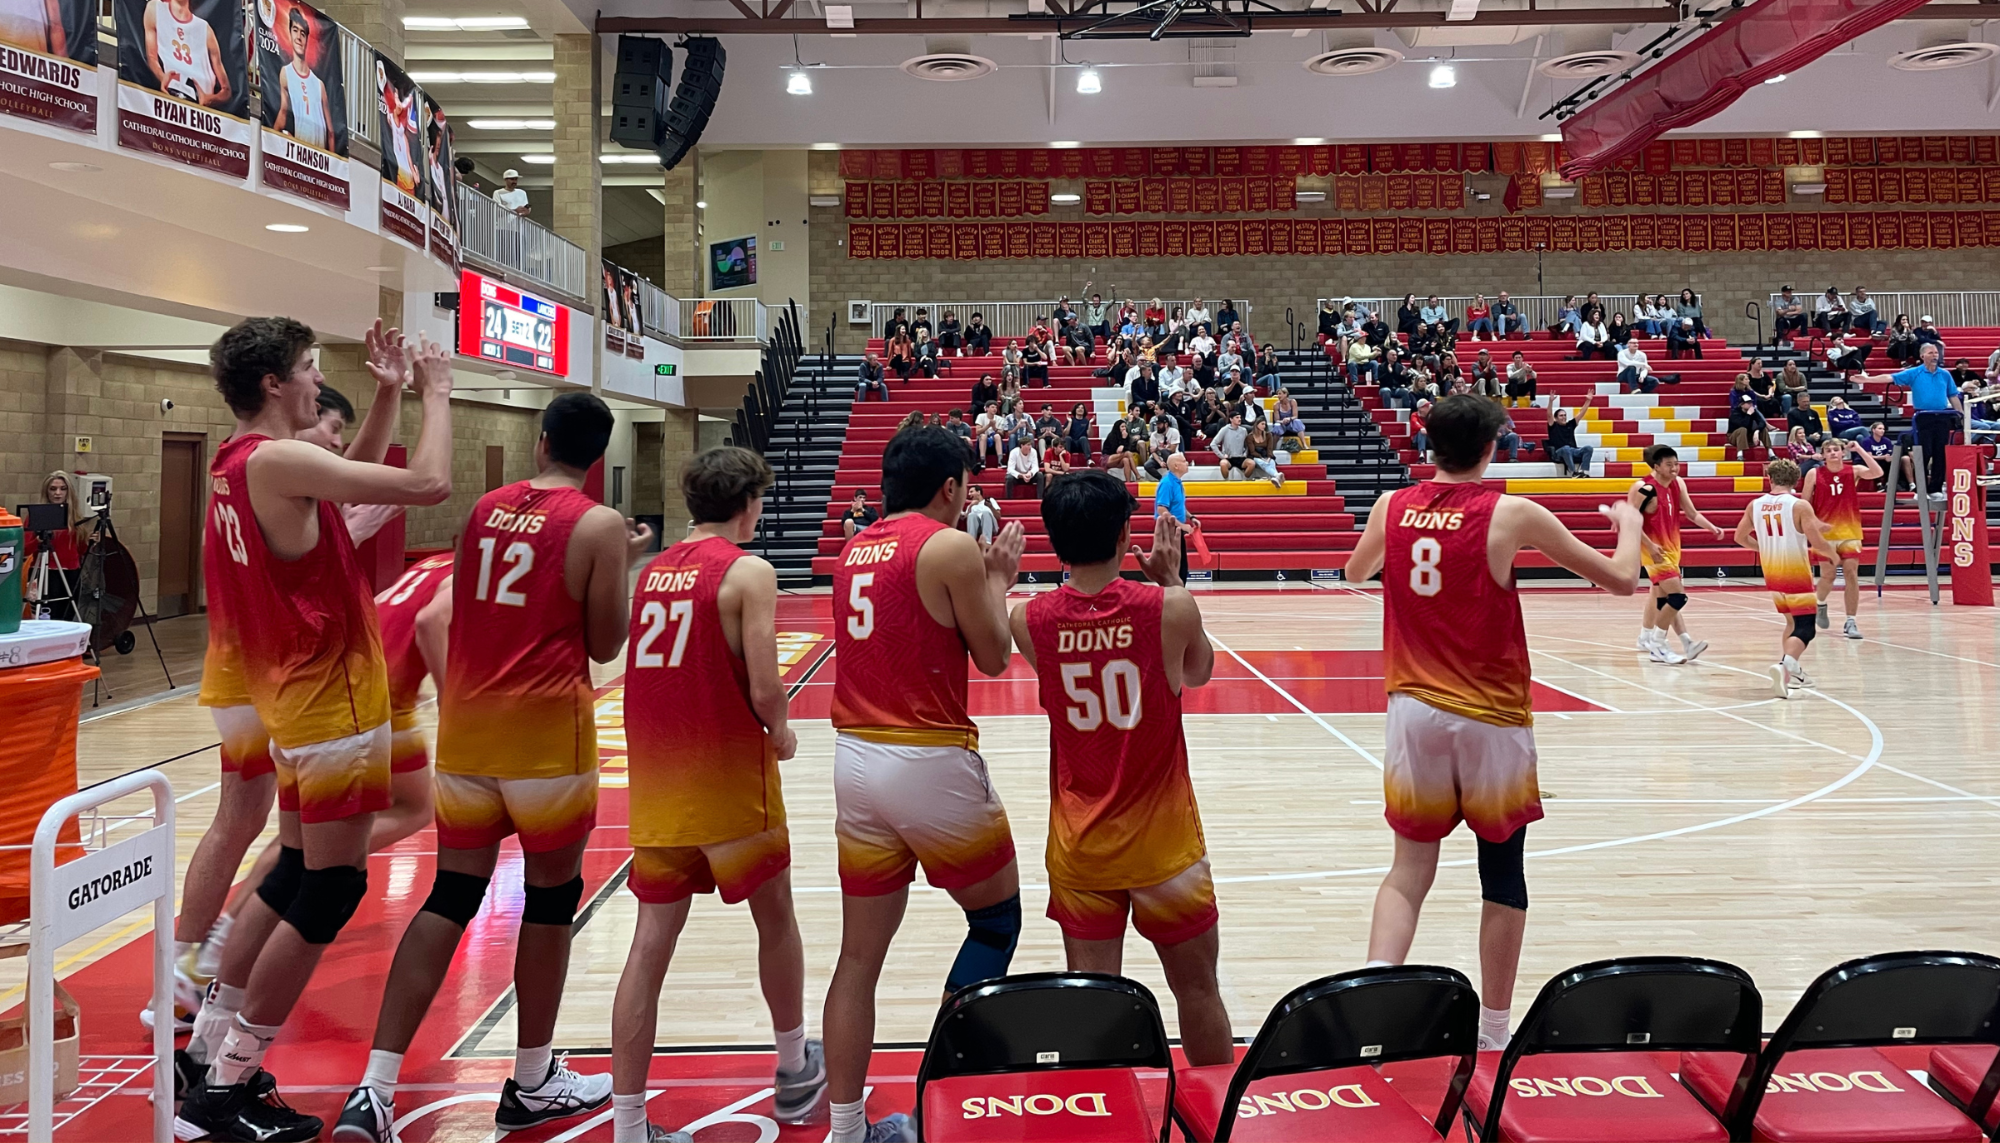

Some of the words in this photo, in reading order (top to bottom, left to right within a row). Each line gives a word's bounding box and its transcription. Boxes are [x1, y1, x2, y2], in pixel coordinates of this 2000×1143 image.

[171, 39, 193, 66] 33
[258, 35, 280, 56] 2024
[0, 47, 81, 89] EDWARDS
[29, 88, 53, 104] HIGH
[54, 97, 90, 114] SCHOOL
[154, 98, 187, 125] RYAN
[190, 108, 222, 135] ENOS
[122, 120, 166, 139] CATHEDRAL
[165, 130, 201, 149] CATHOLIC
[201, 142, 220, 155] HIGH
[219, 147, 246, 161] SCHOOL
[152, 141, 174, 155] DONS
[177, 149, 221, 167] VOLLEYBALL
[285, 141, 296, 158] JT
[296, 145, 330, 173] HANSON
[264, 160, 293, 181] CATHEDRAL
[293, 171, 316, 186] CATHOLIC
[315, 177, 328, 190] HIGH
[327, 182, 346, 195] SCHOOL
[851, 227, 872, 235] WESTERN
[1060, 226, 1081, 234] WESTERN
[1086, 226, 1108, 234] WESTERN
[1165, 225, 1186, 233] WESTERN
[1218, 224, 1238, 232] WESTERN
[1684, 218, 1707, 226] WESTERN
[1877, 216, 1899, 224] WESTERN
[486, 306, 502, 340] 24
[525, 322, 530, 340] 2
[537, 323, 552, 353] 22
[661, 365, 673, 375] EXIT
[1398, 508, 1465, 531] DONS
[1761, 503, 1783, 512] DONS
[1952, 469, 1975, 567] DONS
[485, 508, 546, 534] DONS
[1762, 513, 1784, 537] 11
[844, 541, 898, 567] DONS
[1409, 536, 1442, 597] 8
[475, 537, 535, 607] 12
[644, 570, 699, 593] DONS
[847, 572, 875, 641] 5
[635, 599, 694, 669] 27
[1057, 621, 1096, 629] CATHEDRAL
[1097, 616, 1132, 627] CATHOLIC
[1057, 624, 1134, 653] DONS
[1060, 658, 1142, 732] 50
[68, 855, 152, 911] GATORADE
[1509, 1076, 1664, 1098] DONS
[961, 1093, 1112, 1119] DONS
[1237, 1084, 1381, 1119] DONS
